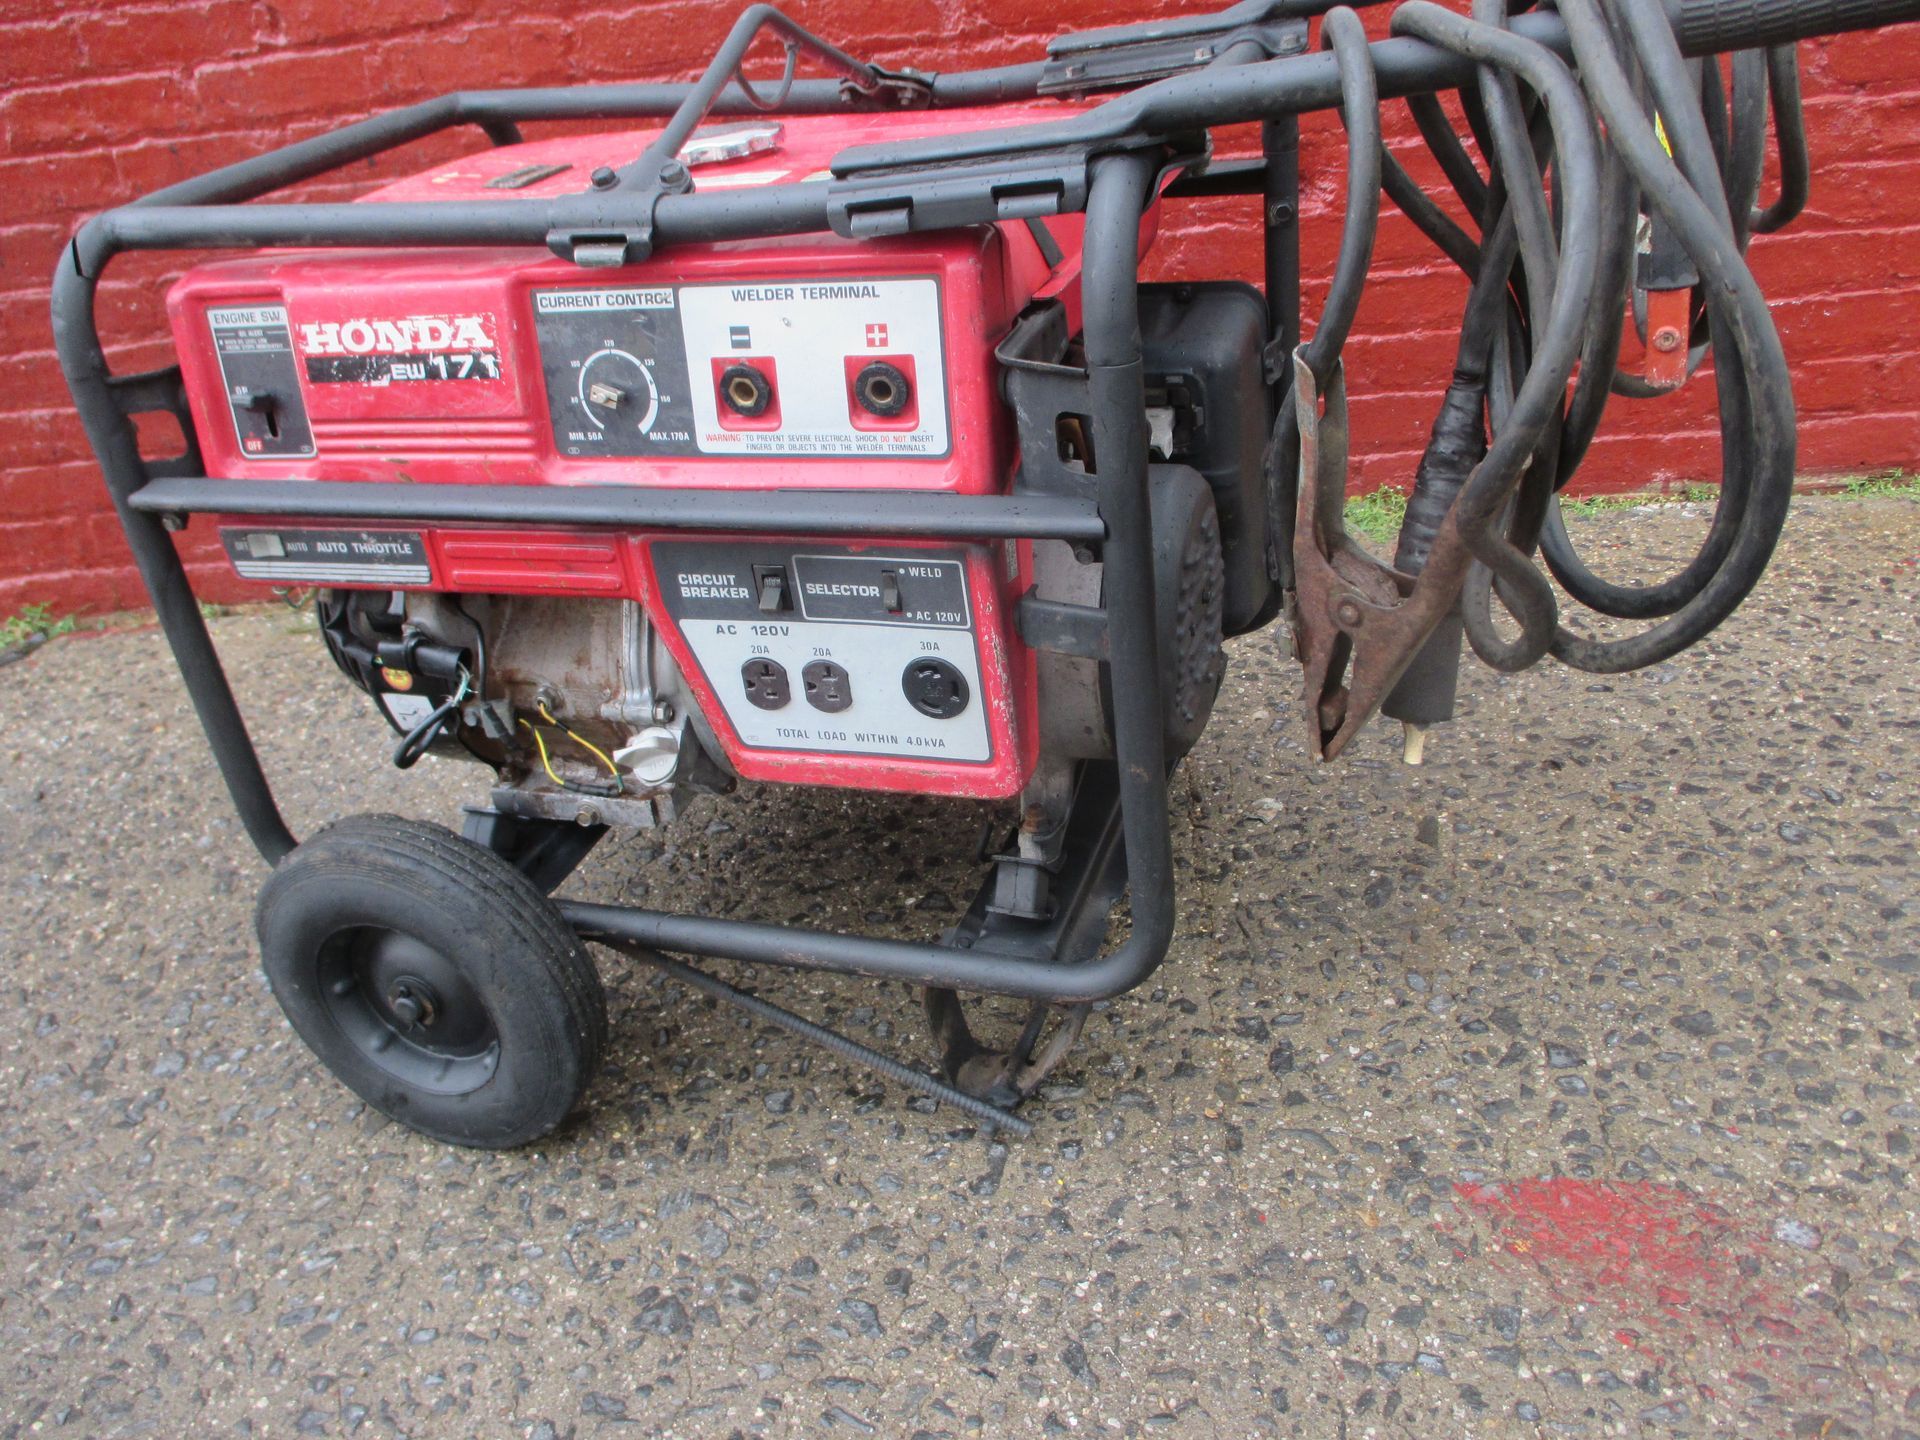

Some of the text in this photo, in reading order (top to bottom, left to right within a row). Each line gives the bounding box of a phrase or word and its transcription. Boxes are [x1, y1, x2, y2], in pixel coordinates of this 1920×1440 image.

[731, 285, 880, 302] WELDER TERMINAL
[539, 292, 673, 308] CURRENT CONTROL
[213, 310, 284, 324] ENGINE SW.
[301, 317, 495, 353] HONDA
[604, 339, 615, 347] 120
[390, 363, 426, 380] EW
[756, 434, 785, 442] PREVENT
[788, 434, 811, 442] SEVERE
[814, 434, 852, 442] ELECTRICAL
[855, 434, 878, 443] SHOCK
[893, 435, 907, 443] NOT
[910, 434, 934, 442] INSERT
[746, 443, 773, 451] FINGERS
[788, 443, 817, 451] OBJECTS
[820, 443, 836, 451] INTO
[840, 443, 853, 451] THE
[856, 443, 884, 451] WELDER
[887, 443, 926, 451] TERMINALS
[287, 542, 308, 551] AUTO
[316, 542, 413, 554] AUTO THROTTLE
[908, 567, 942, 578] WELD
[678, 573, 736, 586] CIRCUIT
[680, 586, 749, 599] BREAKER
[806, 583, 880, 597] SELECTOR
[916, 611, 962, 623] AC 120V
[716, 624, 789, 637] AC 120V
[751, 644, 770, 655] 20A
[920, 640, 941, 652] 30A
[812, 647, 832, 658] 20A
[776, 728, 811, 740] TOTAL
[818, 731, 847, 742] LOAD
[855, 733, 899, 745] WITHIN
